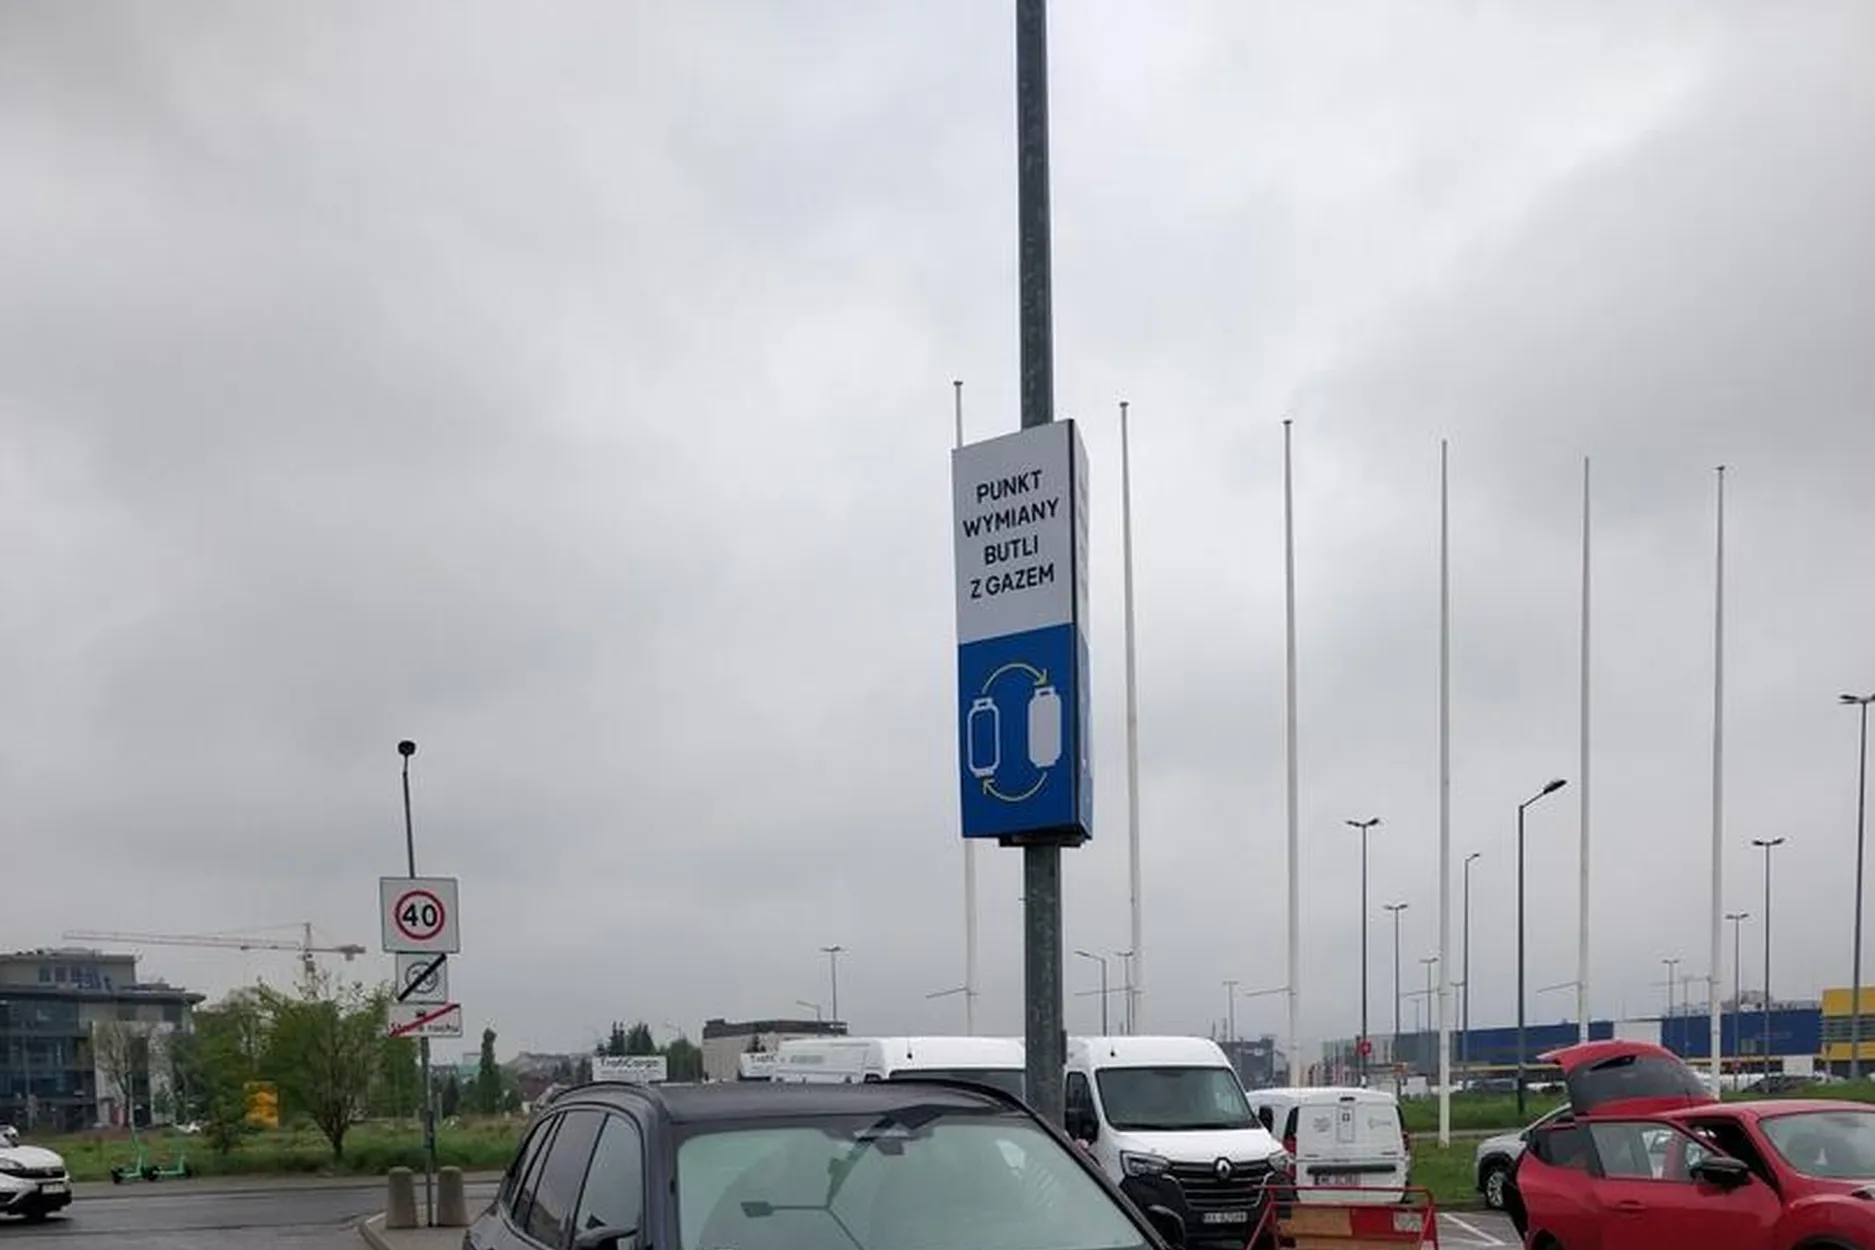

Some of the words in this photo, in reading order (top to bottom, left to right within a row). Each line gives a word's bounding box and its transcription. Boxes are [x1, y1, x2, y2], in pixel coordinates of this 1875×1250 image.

[976, 470, 1042, 504] PUNKT
[962, 497, 1060, 538] WYMIANY
[984, 534, 1039, 565] BUTLI
[970, 579, 983, 599] Z
[985, 562, 1055, 596] GAZEM
[402, 903, 438, 927] 40
